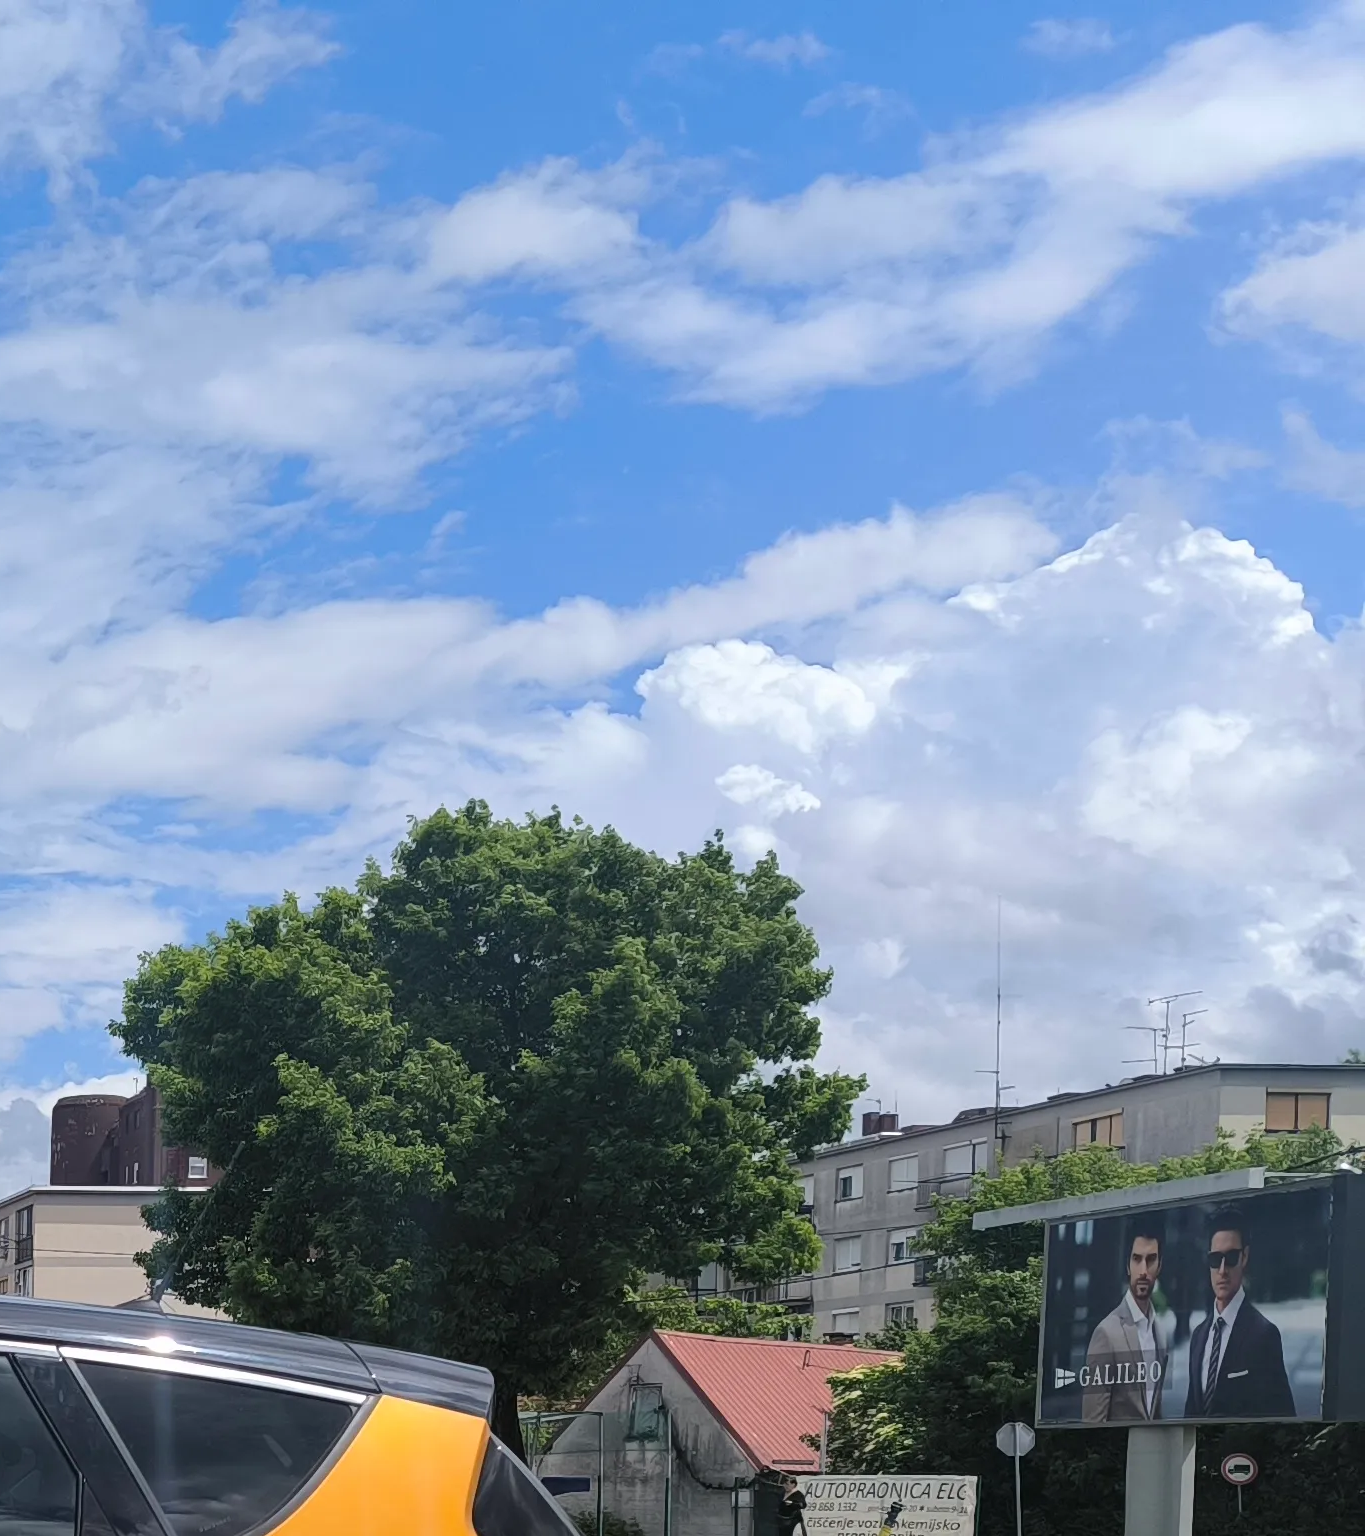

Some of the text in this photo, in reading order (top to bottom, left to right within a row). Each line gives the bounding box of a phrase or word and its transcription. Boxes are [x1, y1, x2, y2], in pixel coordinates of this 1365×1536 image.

[1079, 1361, 1162, 1387] GALILEO
[805, 1482, 931, 1499] AUTOPRAONICA
[901, 1518, 961, 1532] kemijsko
